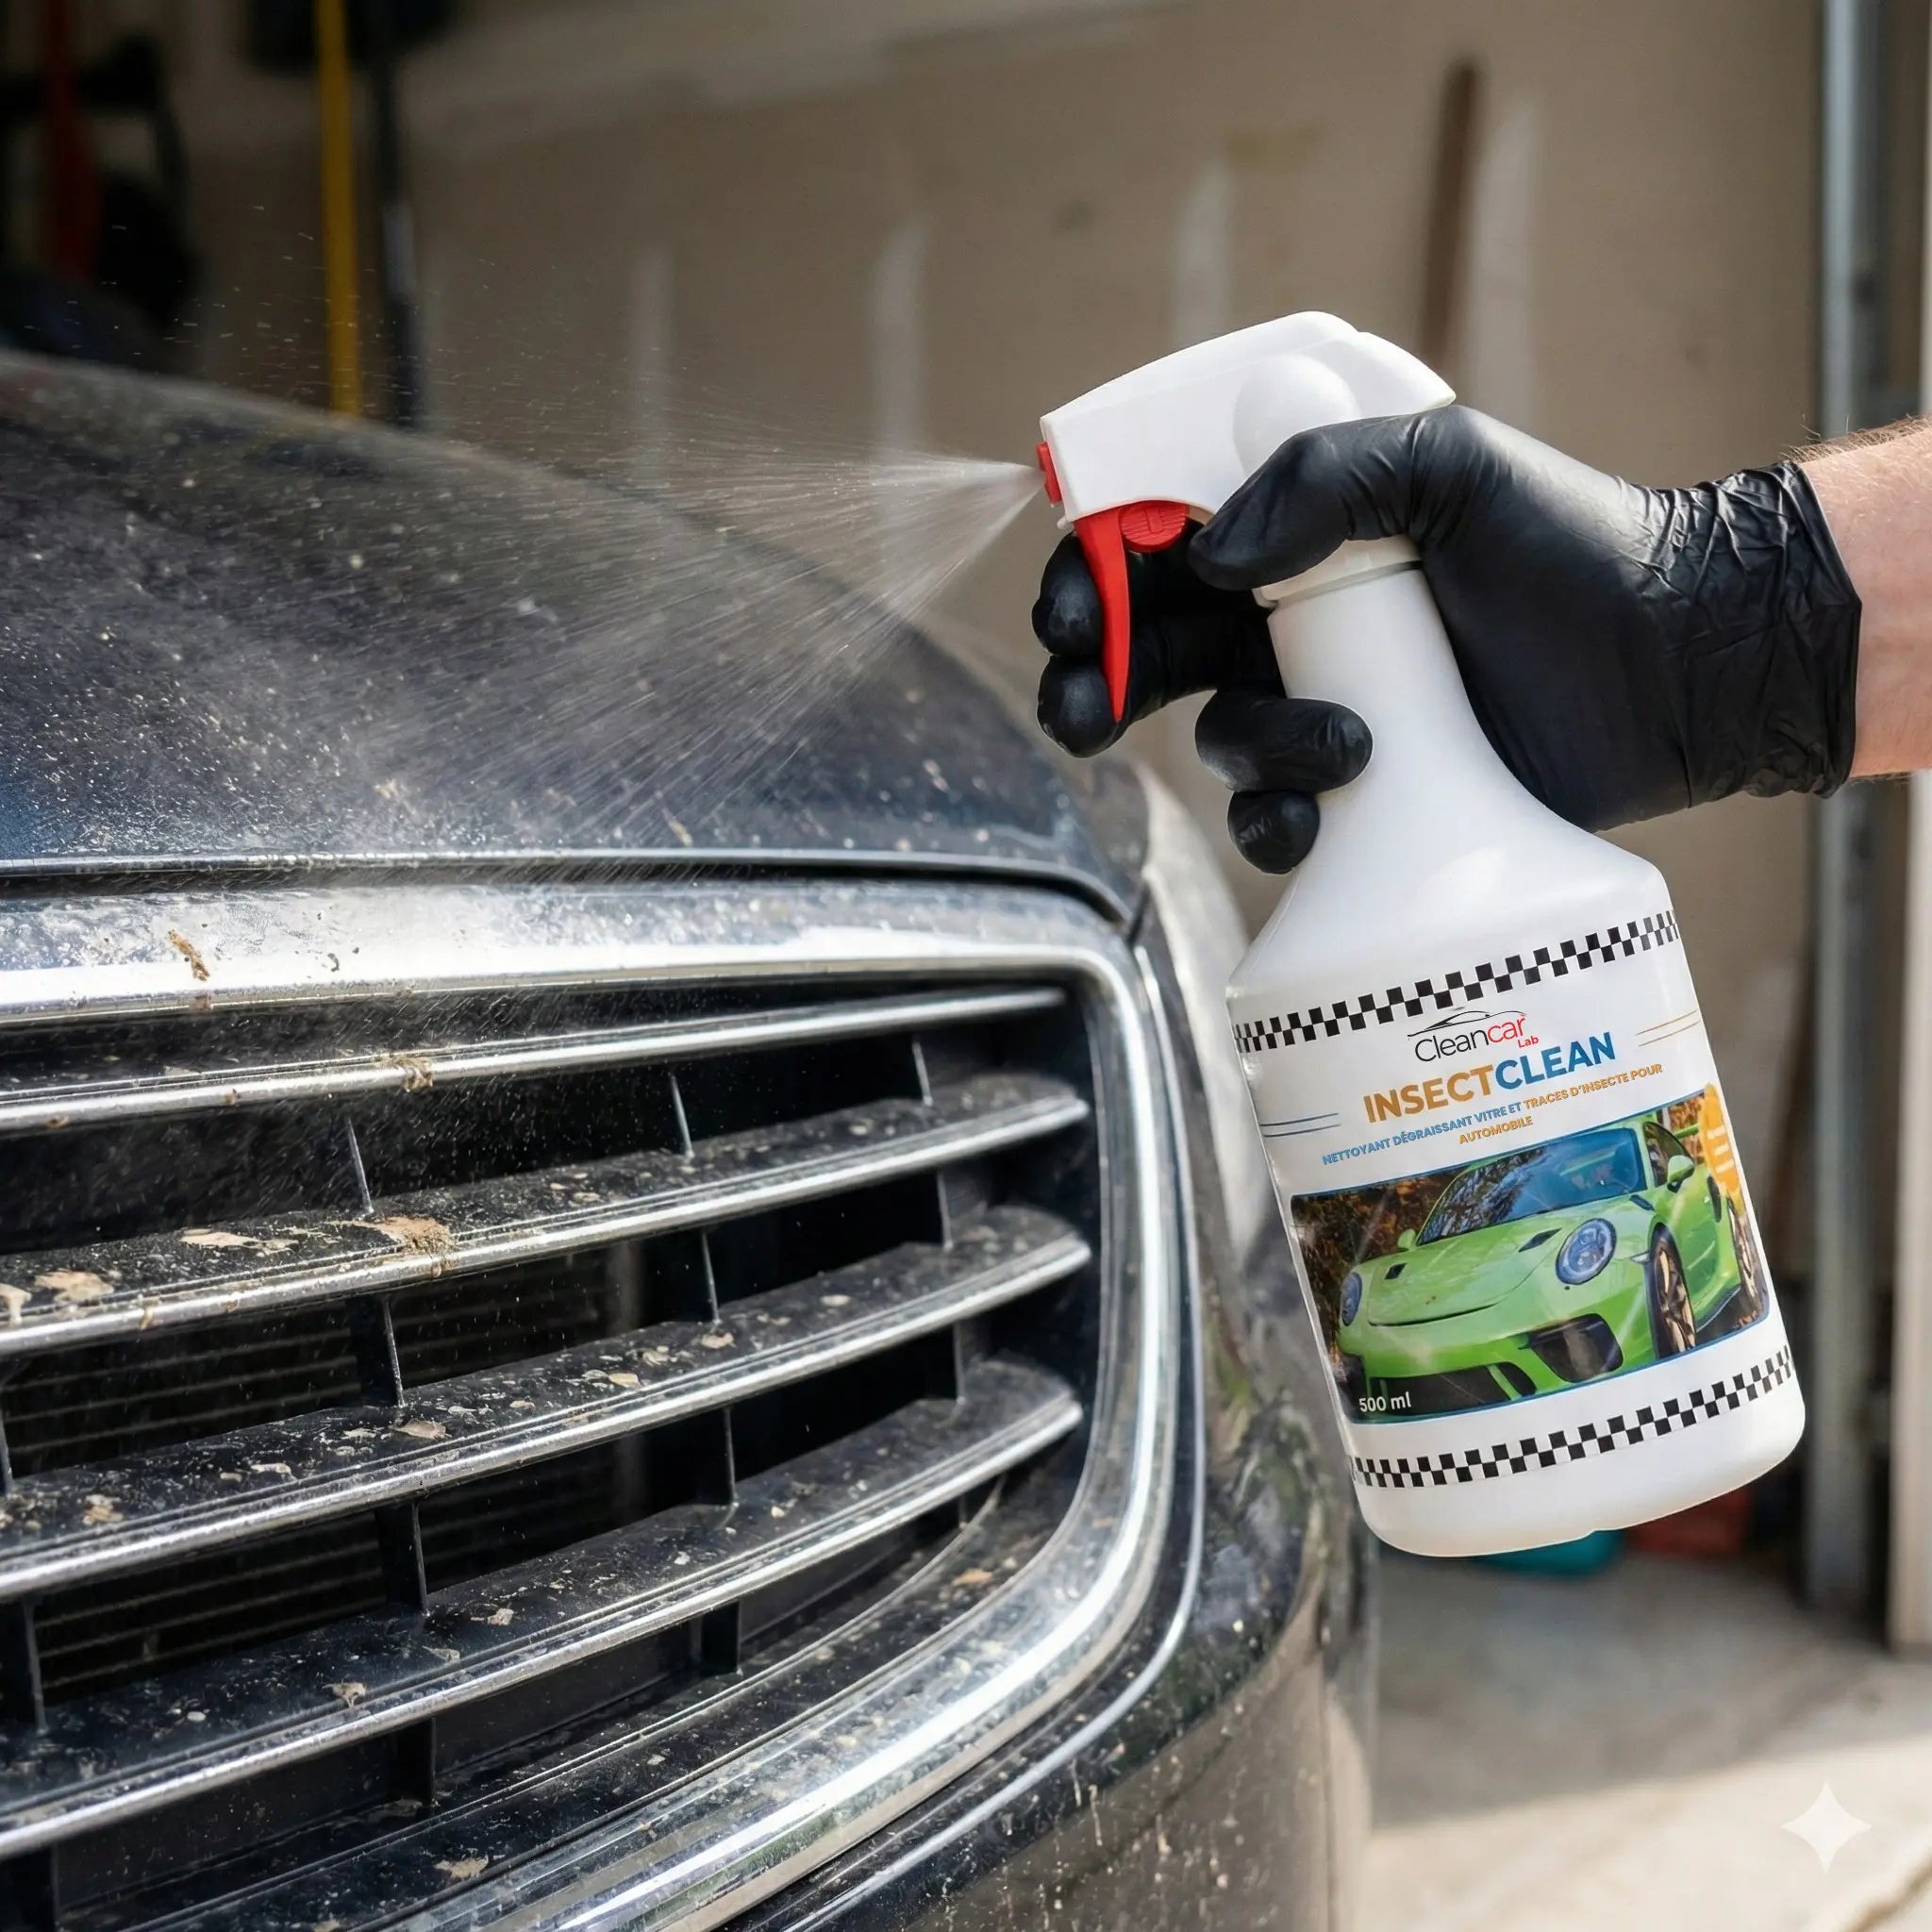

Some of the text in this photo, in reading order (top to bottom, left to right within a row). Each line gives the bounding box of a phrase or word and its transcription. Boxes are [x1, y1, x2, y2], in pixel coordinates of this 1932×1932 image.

[1415, 1014, 1525, 1062] Cleancar
[1518, 1035, 1539, 1048] Lab
[1323, 1063, 1663, 1165] NETTOYANT DÉGRAISSANT VITRE ET TRACES D'INSECTE POUR
[1458, 1115, 1534, 1144] AUTOMOBILE
[1358, 1391, 1411, 1412] 500 ml
